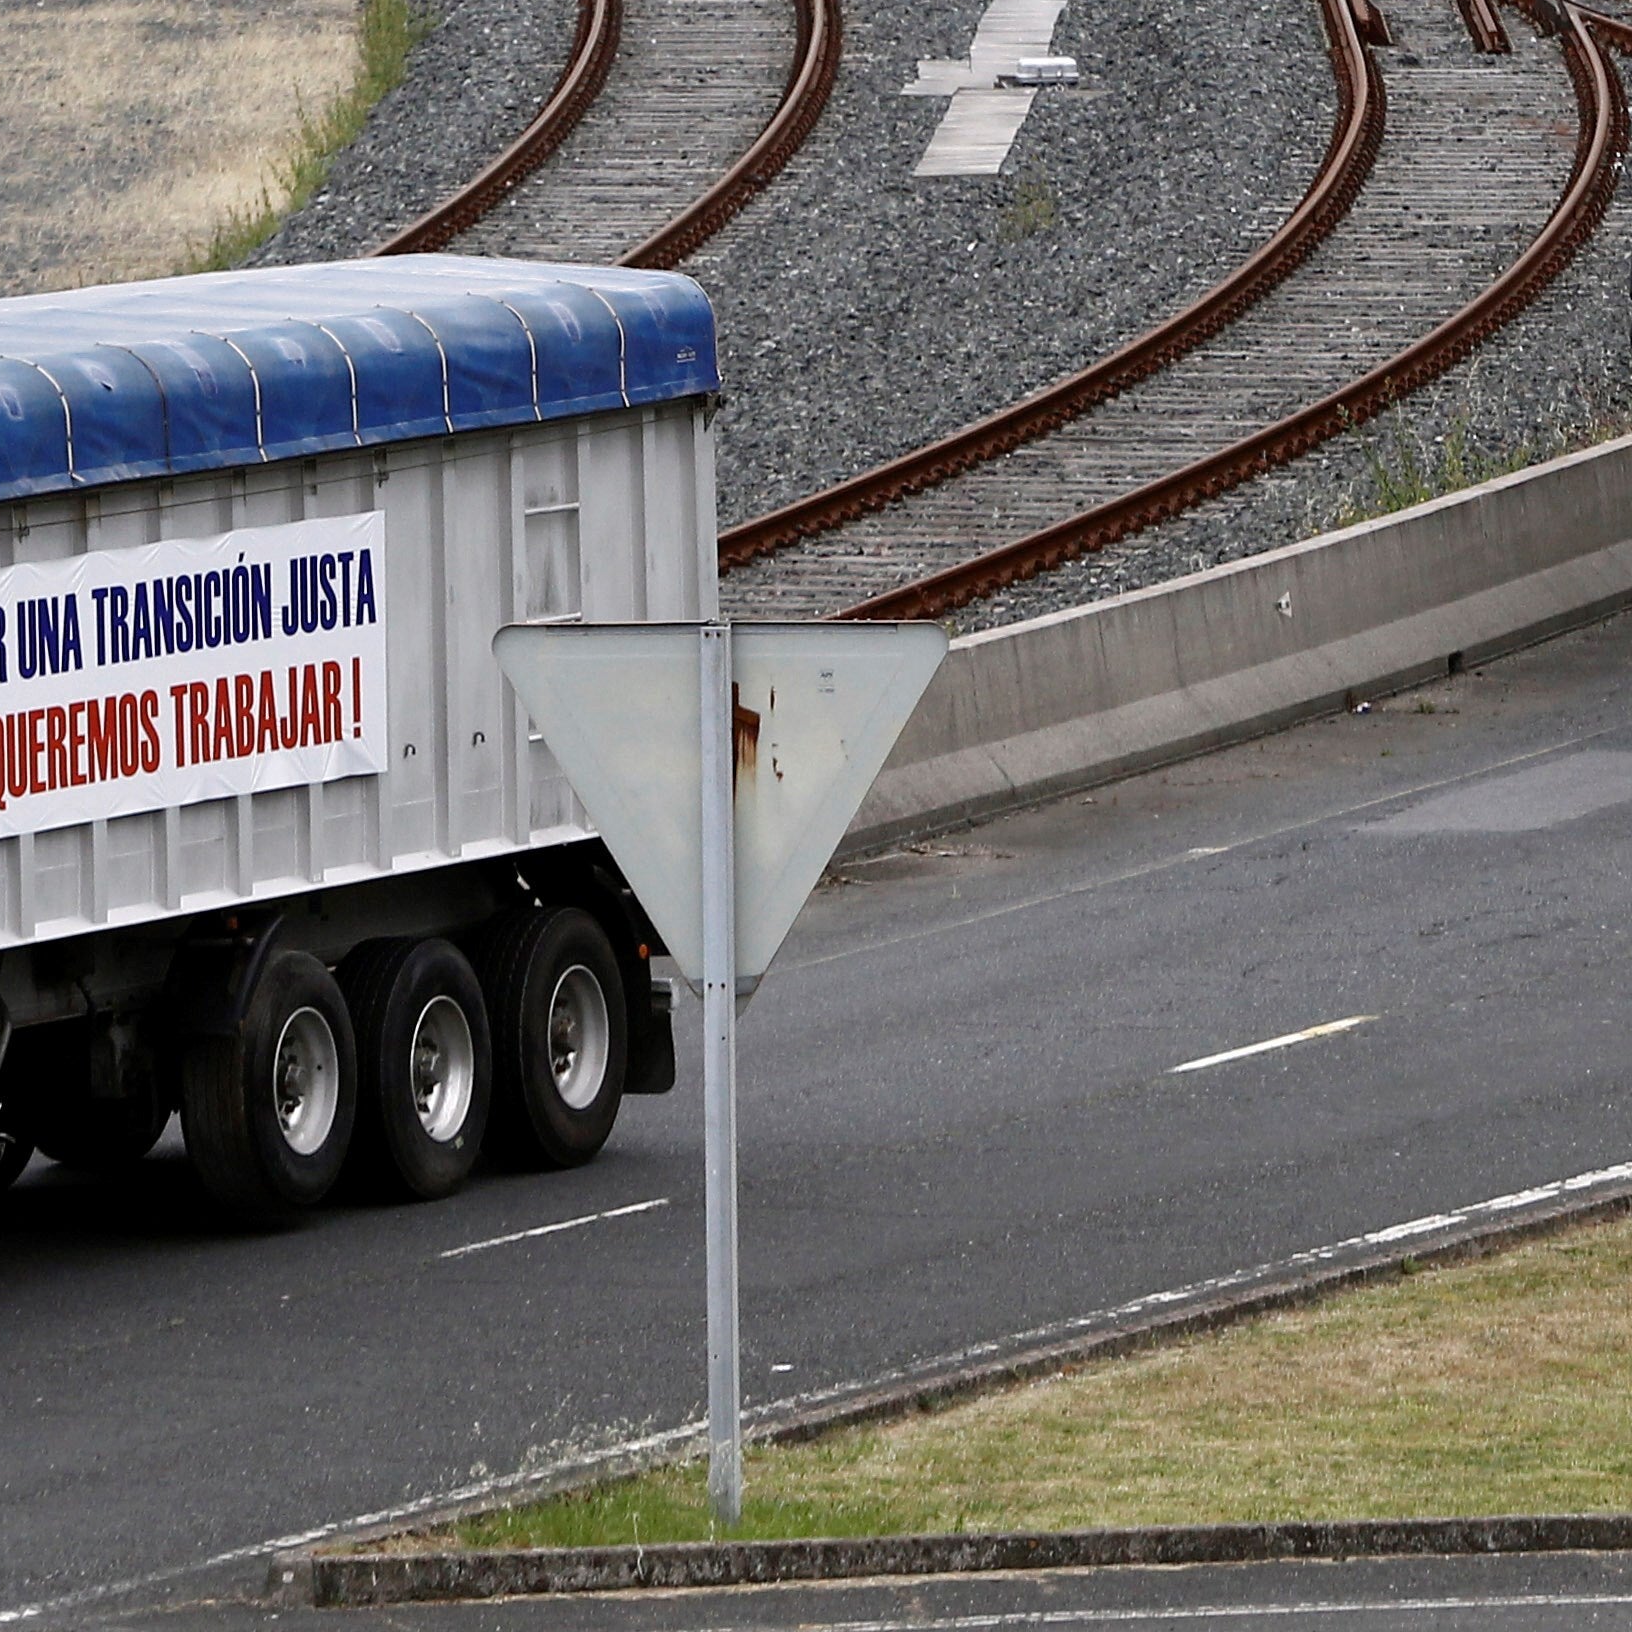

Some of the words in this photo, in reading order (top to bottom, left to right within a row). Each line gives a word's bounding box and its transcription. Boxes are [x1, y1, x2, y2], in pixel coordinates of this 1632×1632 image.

[16, 592, 83, 680] UNA
[91, 552, 273, 667] TRANSICIÓN
[281, 548, 377, 637] JUSTA
